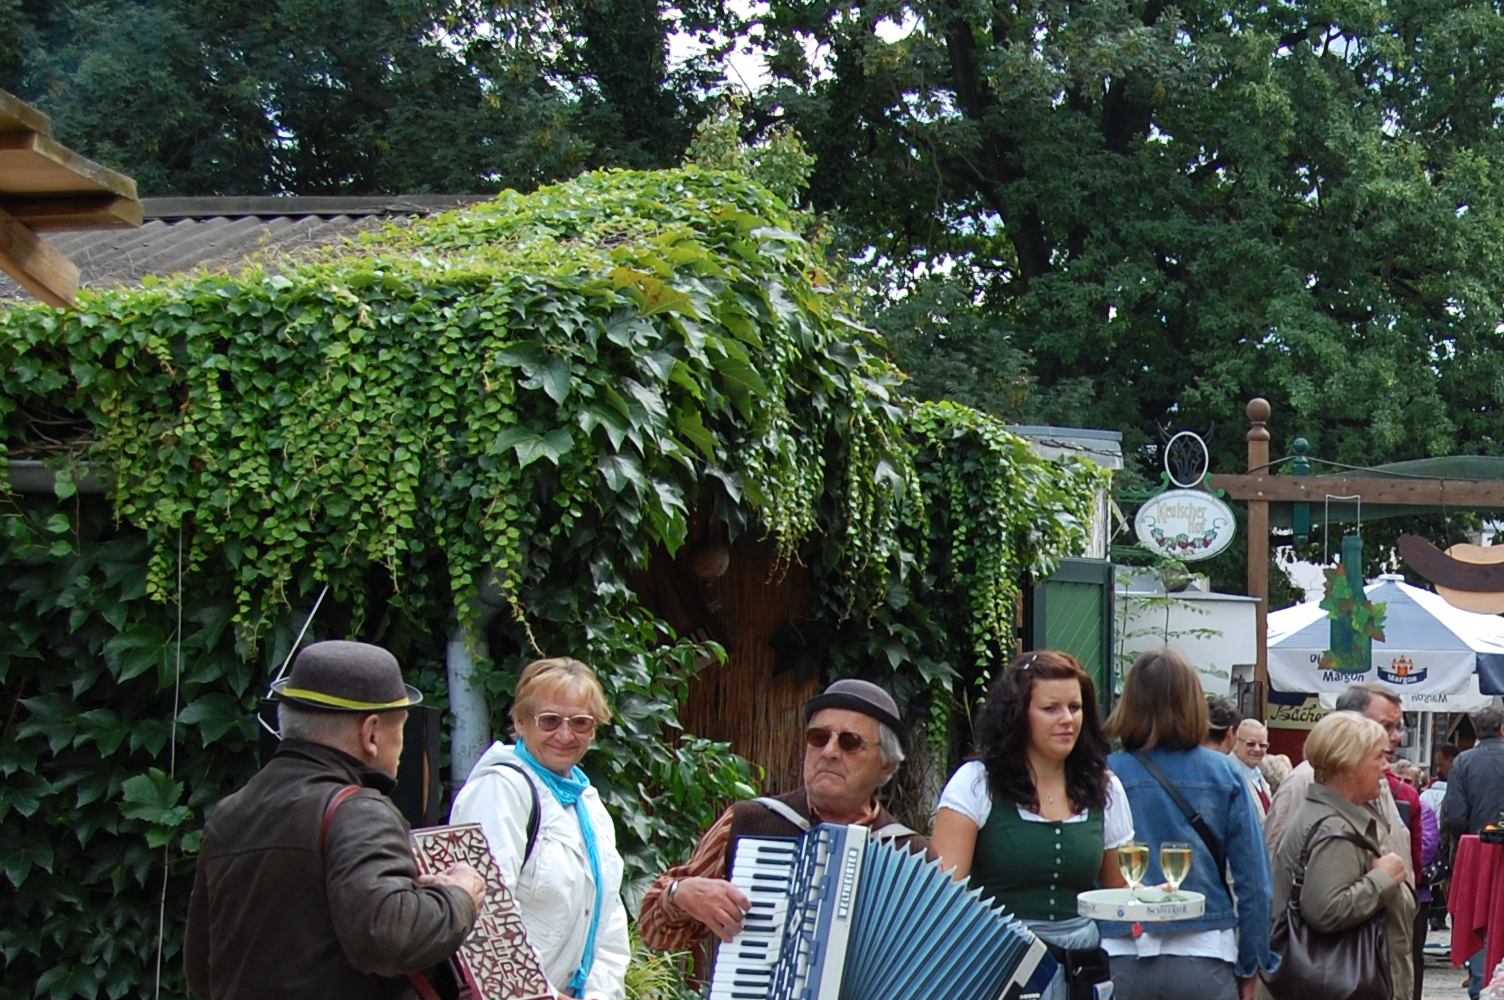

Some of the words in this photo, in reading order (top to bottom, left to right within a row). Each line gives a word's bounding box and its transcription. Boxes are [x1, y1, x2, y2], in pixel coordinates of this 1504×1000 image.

[1323, 671, 1365, 683] Margon
[1387, 674, 1418, 684] Margon
[838, 849, 859, 918] WELTMEISTER
[452, 848, 520, 983] HNER
